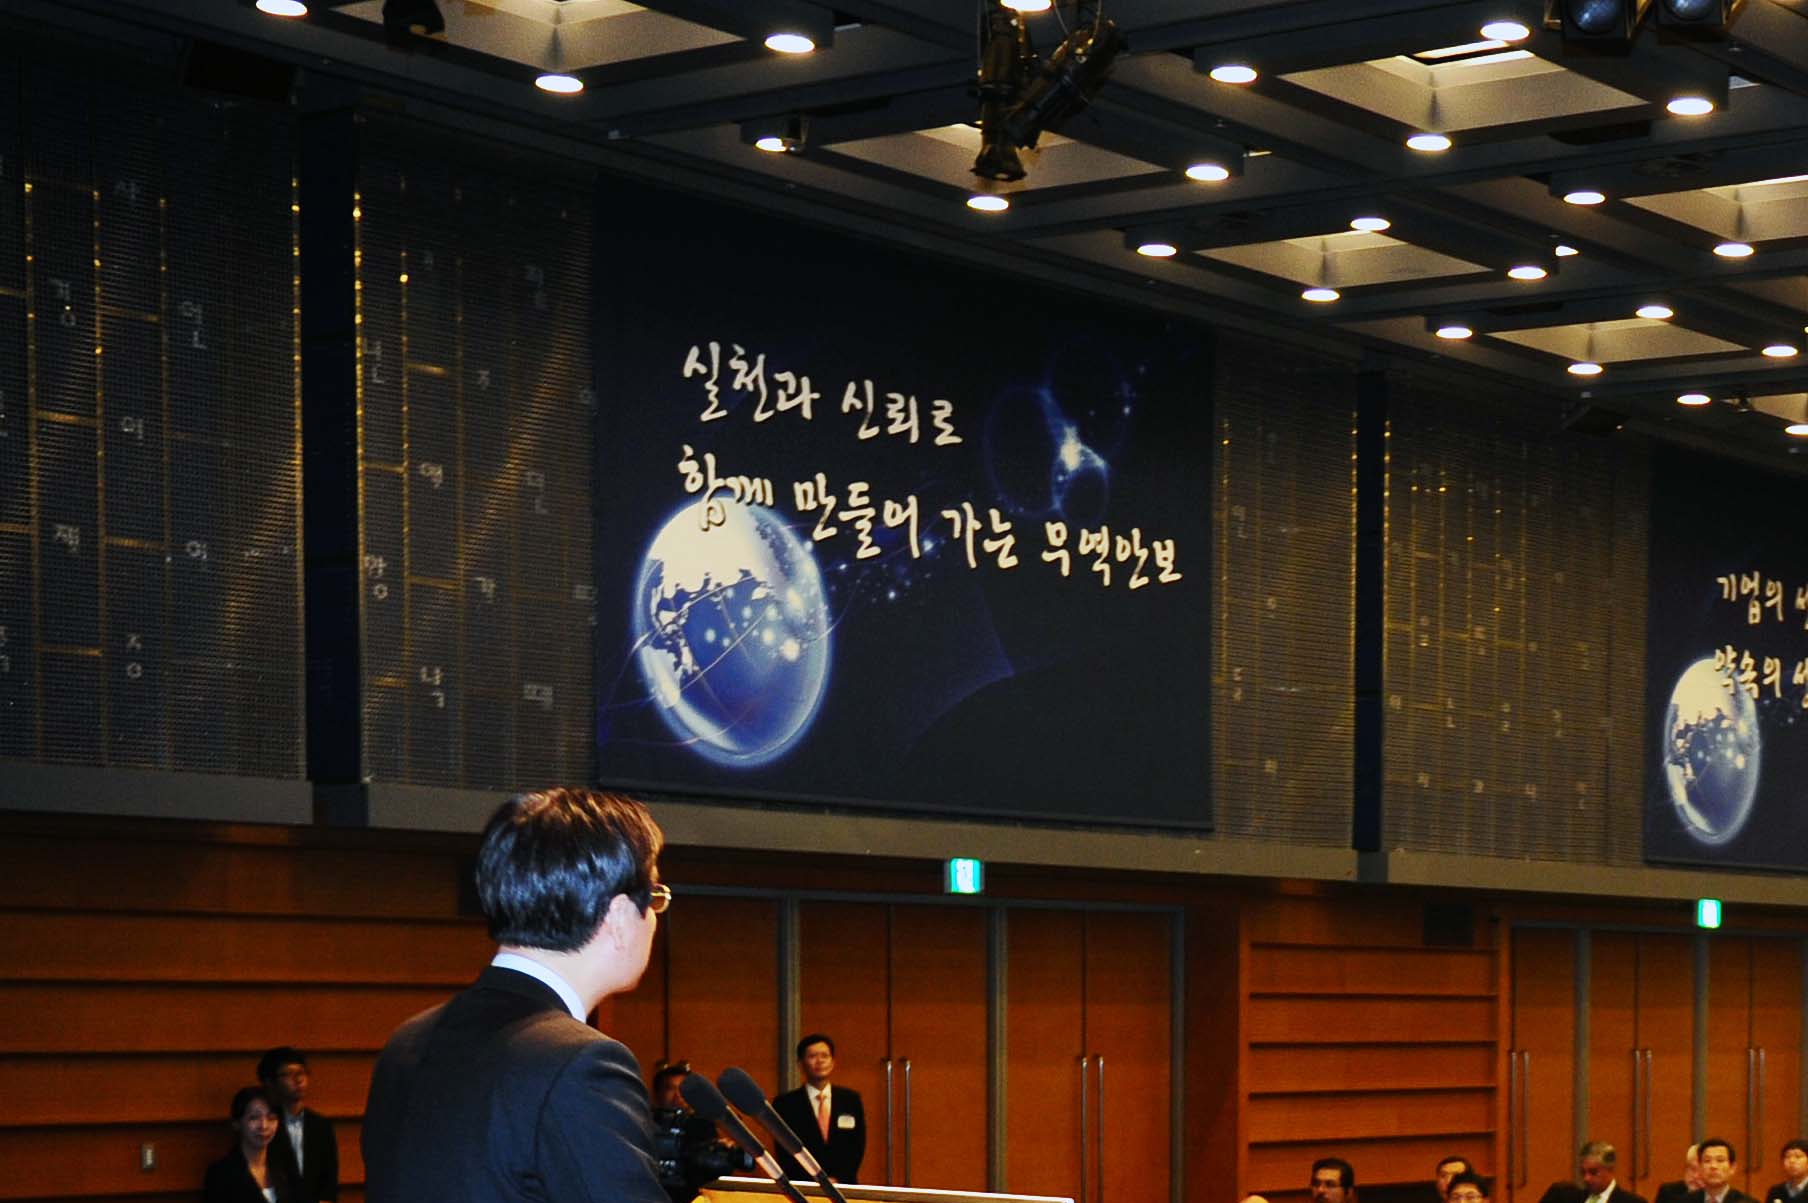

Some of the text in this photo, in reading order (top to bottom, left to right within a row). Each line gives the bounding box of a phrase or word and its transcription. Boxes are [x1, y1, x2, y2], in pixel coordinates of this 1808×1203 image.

[682, 341, 963, 446] 실천과 신뢰로
[678, 444, 1184, 590] 함께 만들어 가는 무역안보
[1716, 570, 1784, 625] 기업의
[1713, 644, 1782, 699] 약속의
